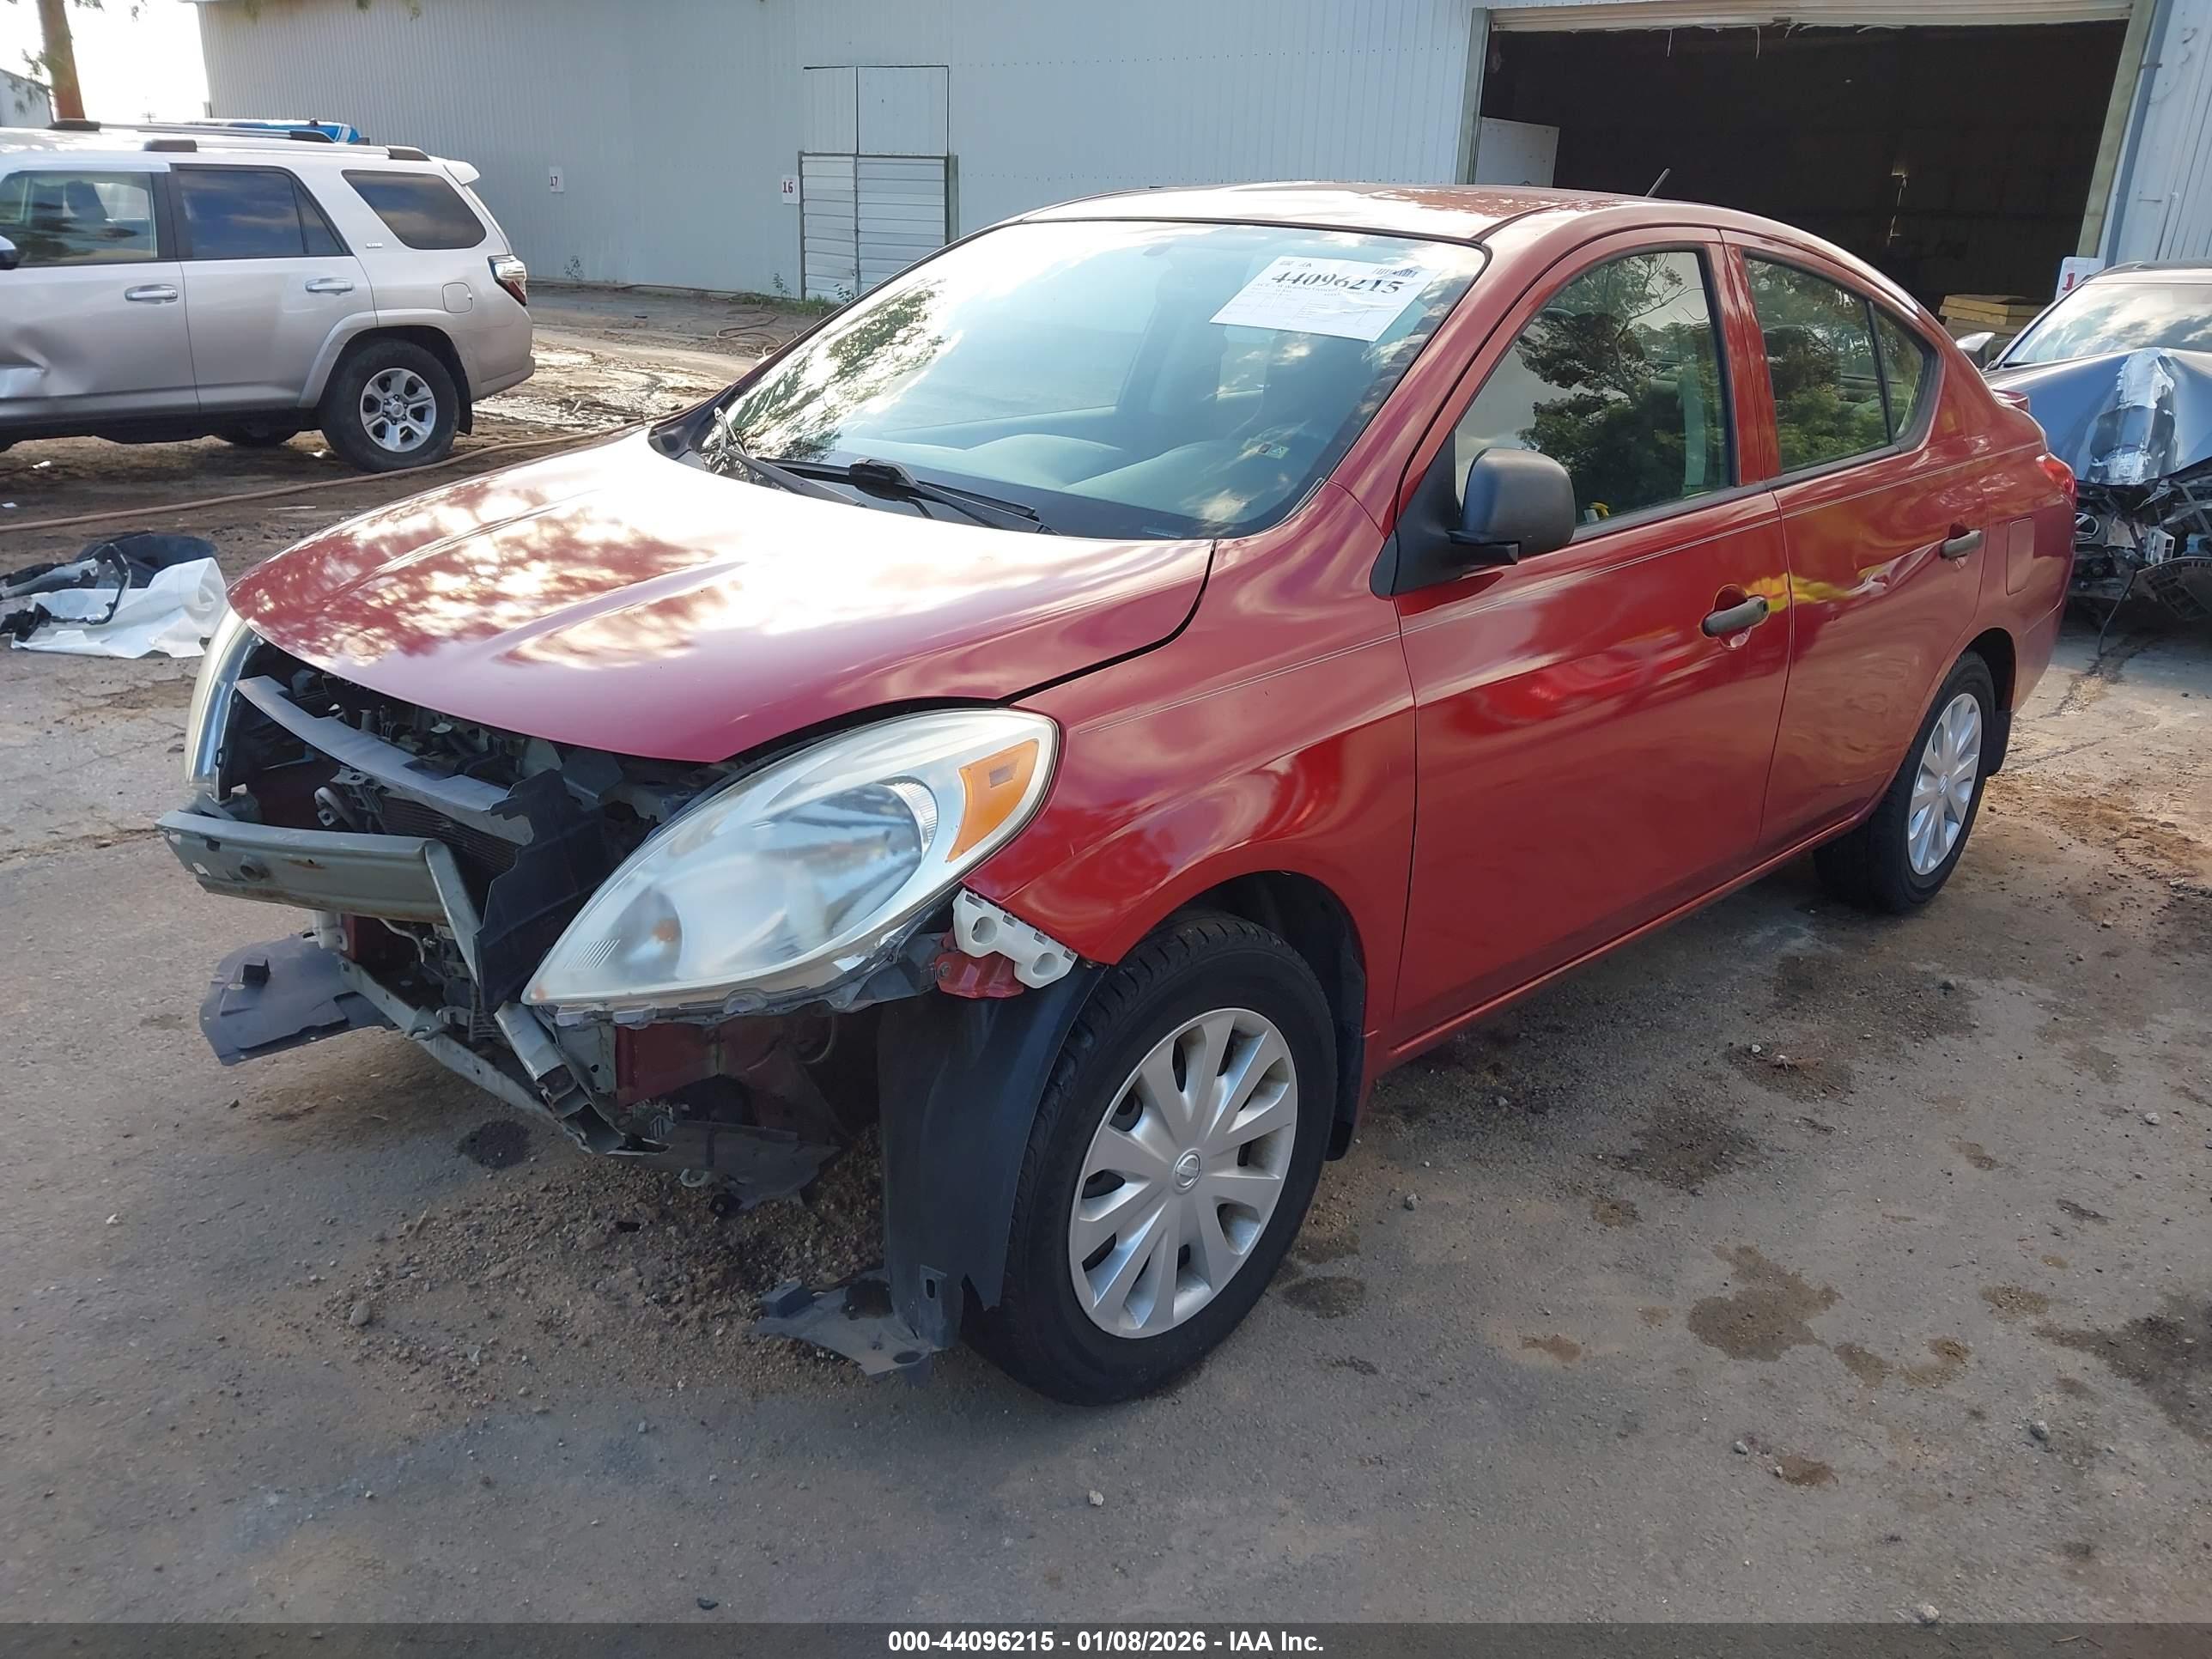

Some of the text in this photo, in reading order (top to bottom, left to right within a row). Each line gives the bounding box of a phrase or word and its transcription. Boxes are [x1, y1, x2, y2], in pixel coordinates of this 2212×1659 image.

[550, 176, 558, 186] 17
[783, 181, 793, 193] 16
[1272, 271, 1404, 294] 44096215
